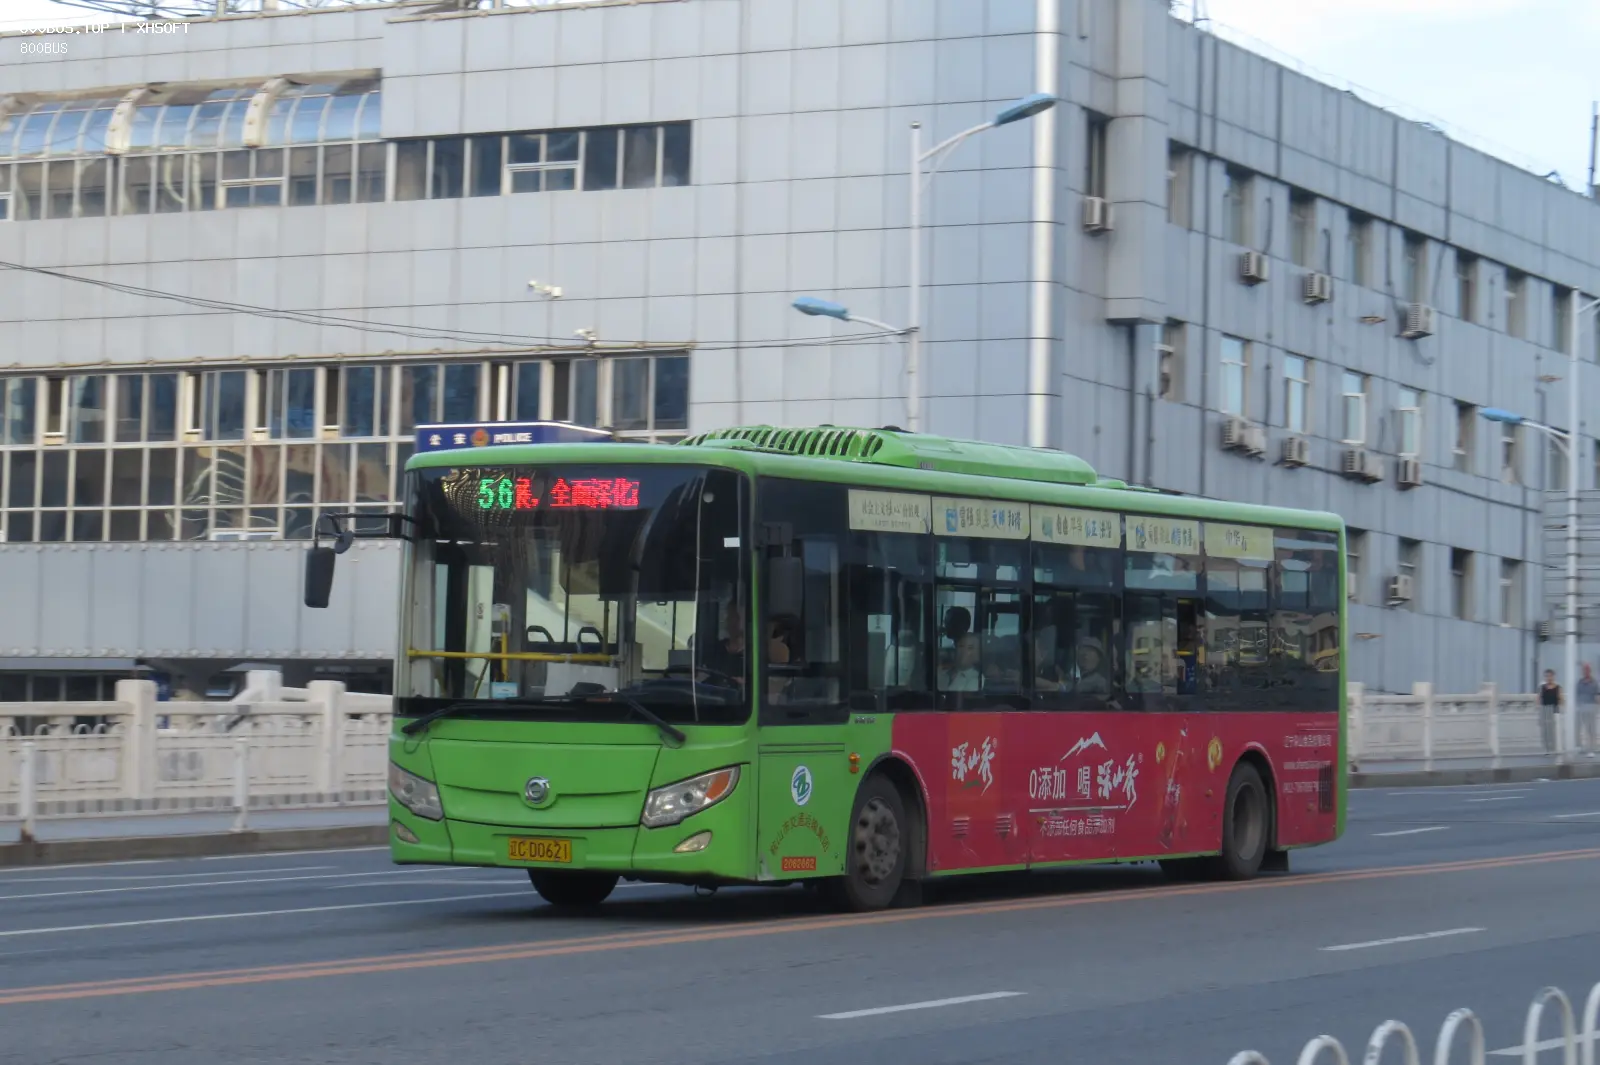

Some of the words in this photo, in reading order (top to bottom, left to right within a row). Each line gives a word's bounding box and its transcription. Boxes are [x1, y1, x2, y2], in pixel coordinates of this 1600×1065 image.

[493, 432, 533, 444] POLICE
[478, 477, 513, 509] 56
[1029, 765, 1066, 800] 0添加
[1077, 765, 1091, 799] 喝
